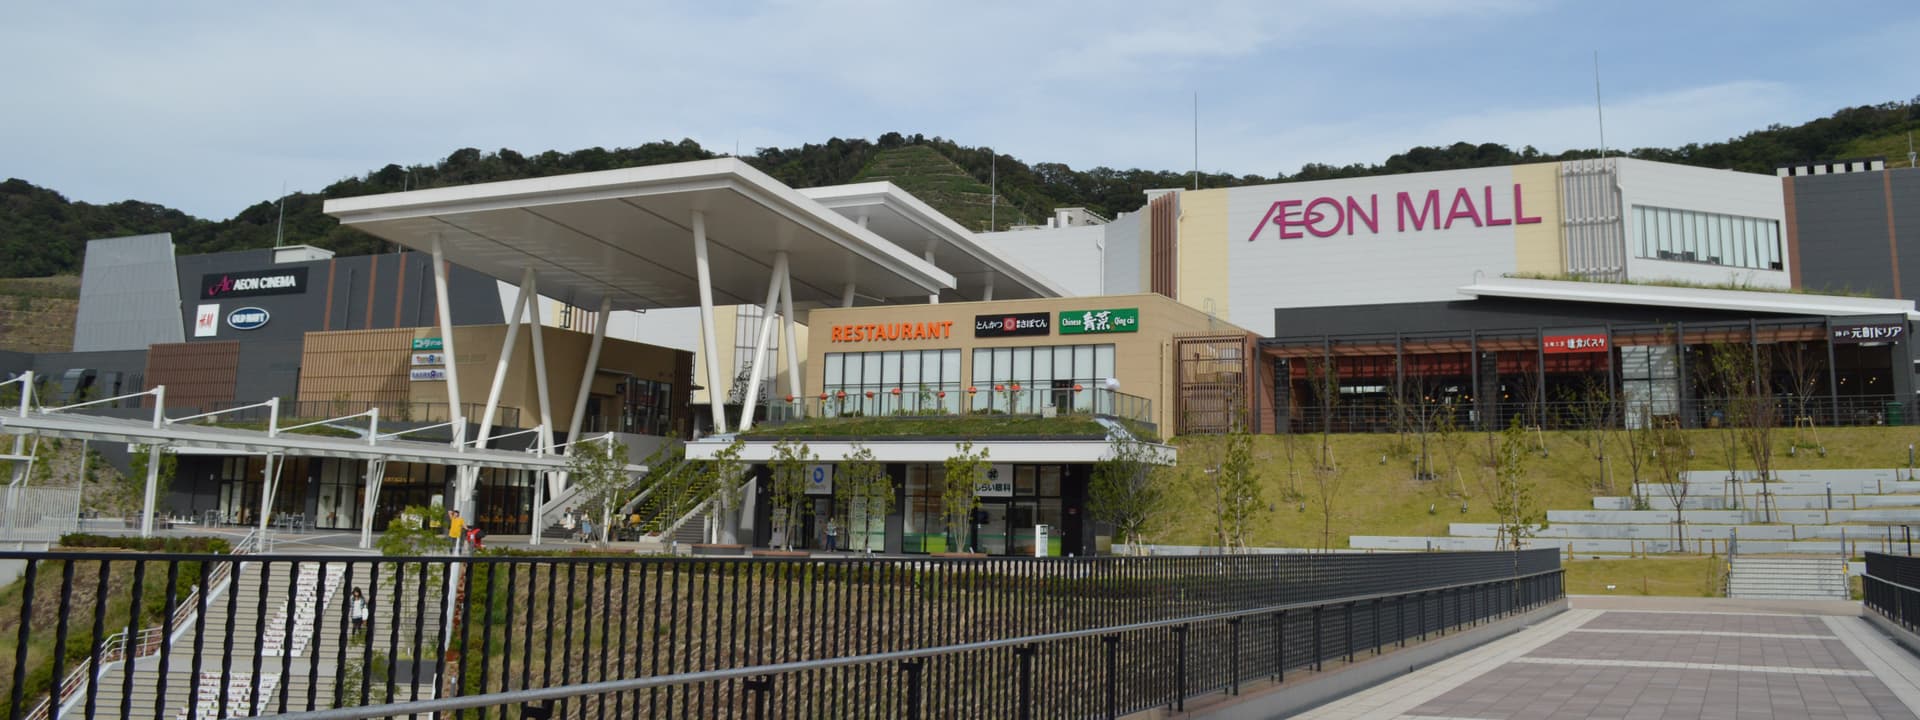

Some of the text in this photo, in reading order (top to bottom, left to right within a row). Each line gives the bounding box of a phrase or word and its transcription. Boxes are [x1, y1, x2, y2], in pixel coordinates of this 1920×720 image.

[1397, 183, 1542, 232] MALL
[233, 277, 260, 291] AEON
[260, 275, 297, 289] CINEMA
[831, 321, 953, 343] RESTAURANT
[976, 320, 1003, 330] とんかつ
[975, 482, 1011, 492] しらい眼科
